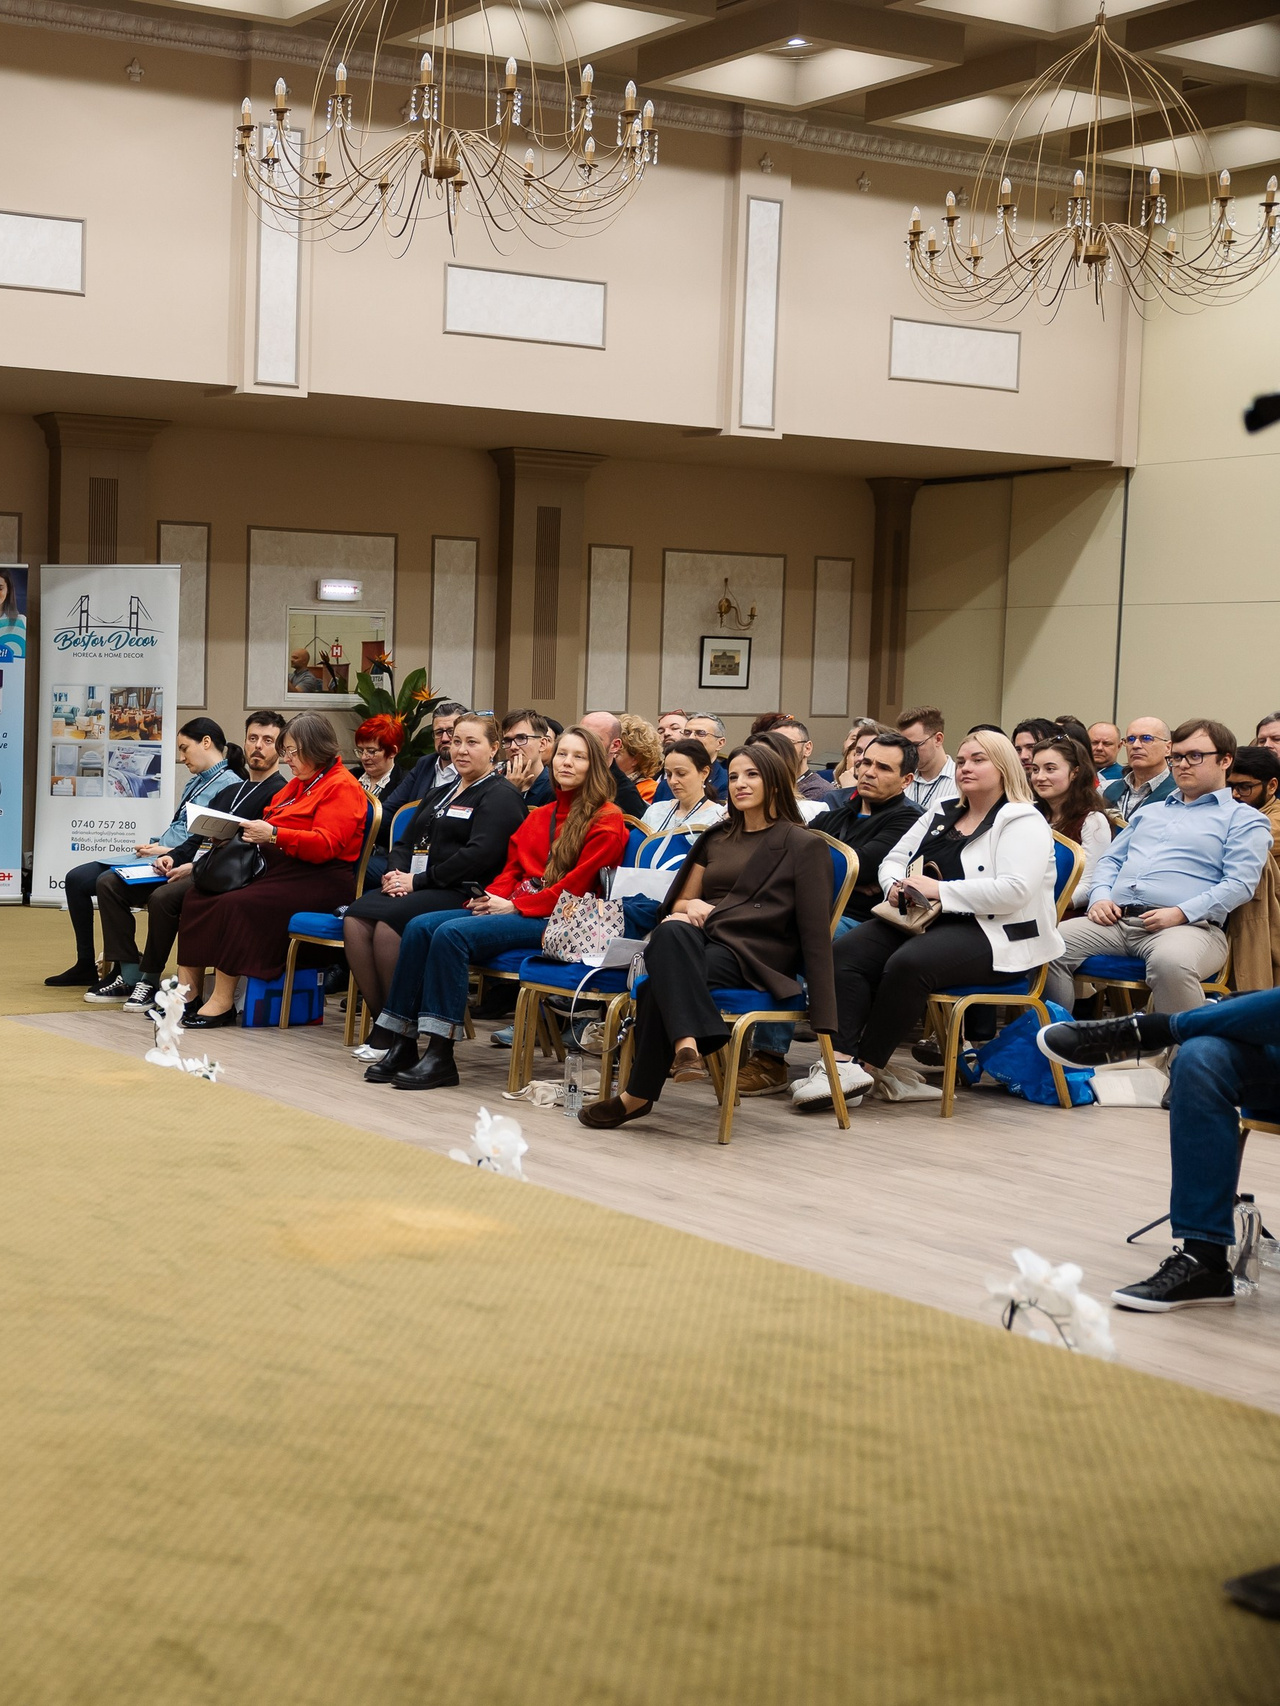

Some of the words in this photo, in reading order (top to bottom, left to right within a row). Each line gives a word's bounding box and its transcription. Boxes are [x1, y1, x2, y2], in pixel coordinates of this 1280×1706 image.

[53, 630, 106, 651] Bosfor
[107, 630, 159, 651] Decor
[71, 820, 95, 829] 0740
[98, 821, 116, 829] 757
[118, 821, 137, 830] 280
[80, 843, 107, 852] Bosfor
[108, 844, 135, 853] Dekor
